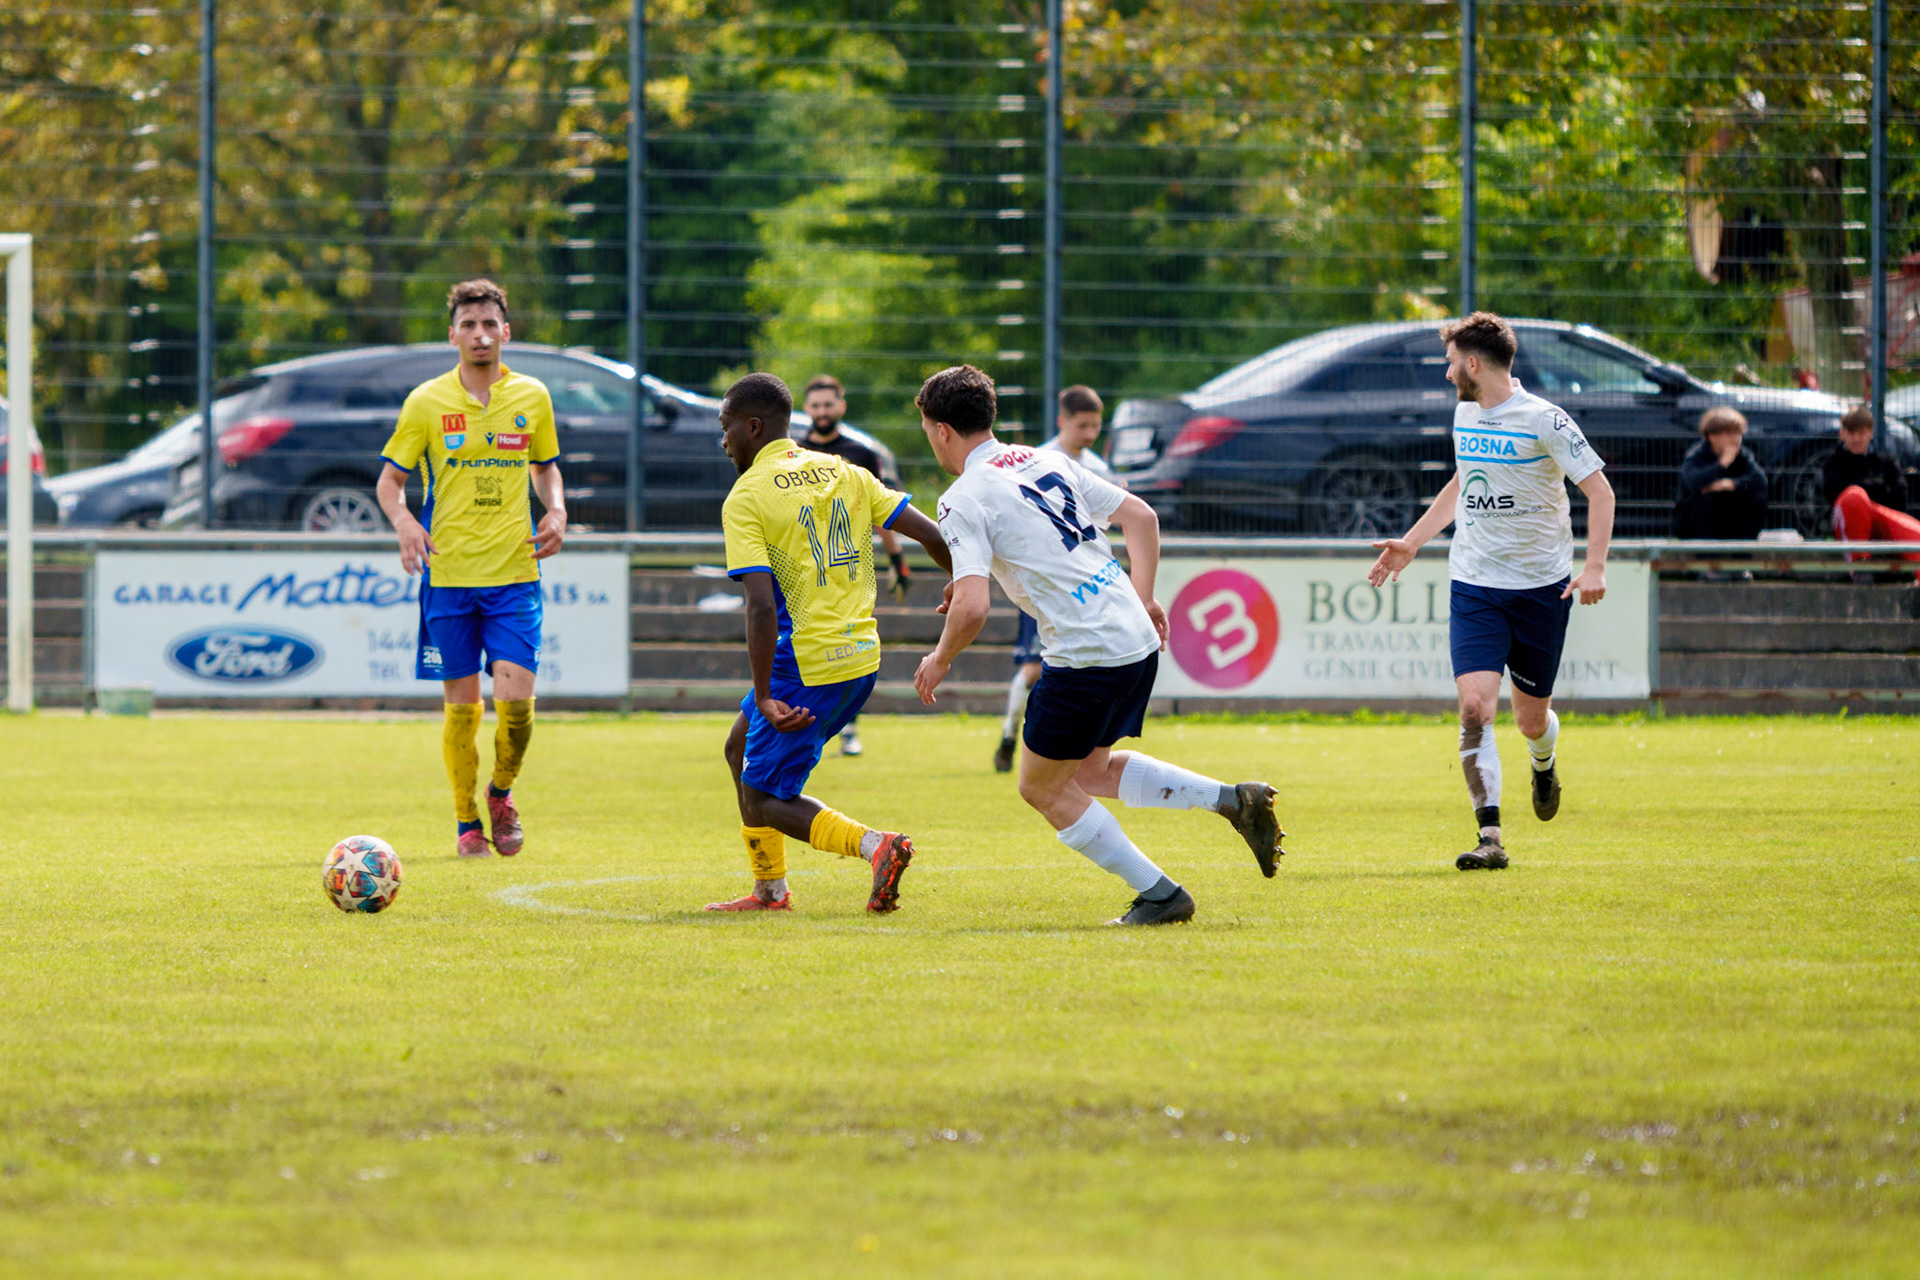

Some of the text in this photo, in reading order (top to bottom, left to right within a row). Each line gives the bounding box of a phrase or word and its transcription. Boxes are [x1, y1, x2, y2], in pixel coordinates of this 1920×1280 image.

[1460, 436, 1518, 456] BOSNA
[774, 467, 838, 489] OBRIST
[1018, 471, 1097, 553] 12
[1466, 495, 1515, 510] SMS
[798, 497, 860, 588] 14
[114, 584, 232, 605] GARAGE
[1305, 580, 1450, 625] BOLL
[1306, 630, 1421, 651] TRAVAUX
[195, 630, 294, 678] Ford
